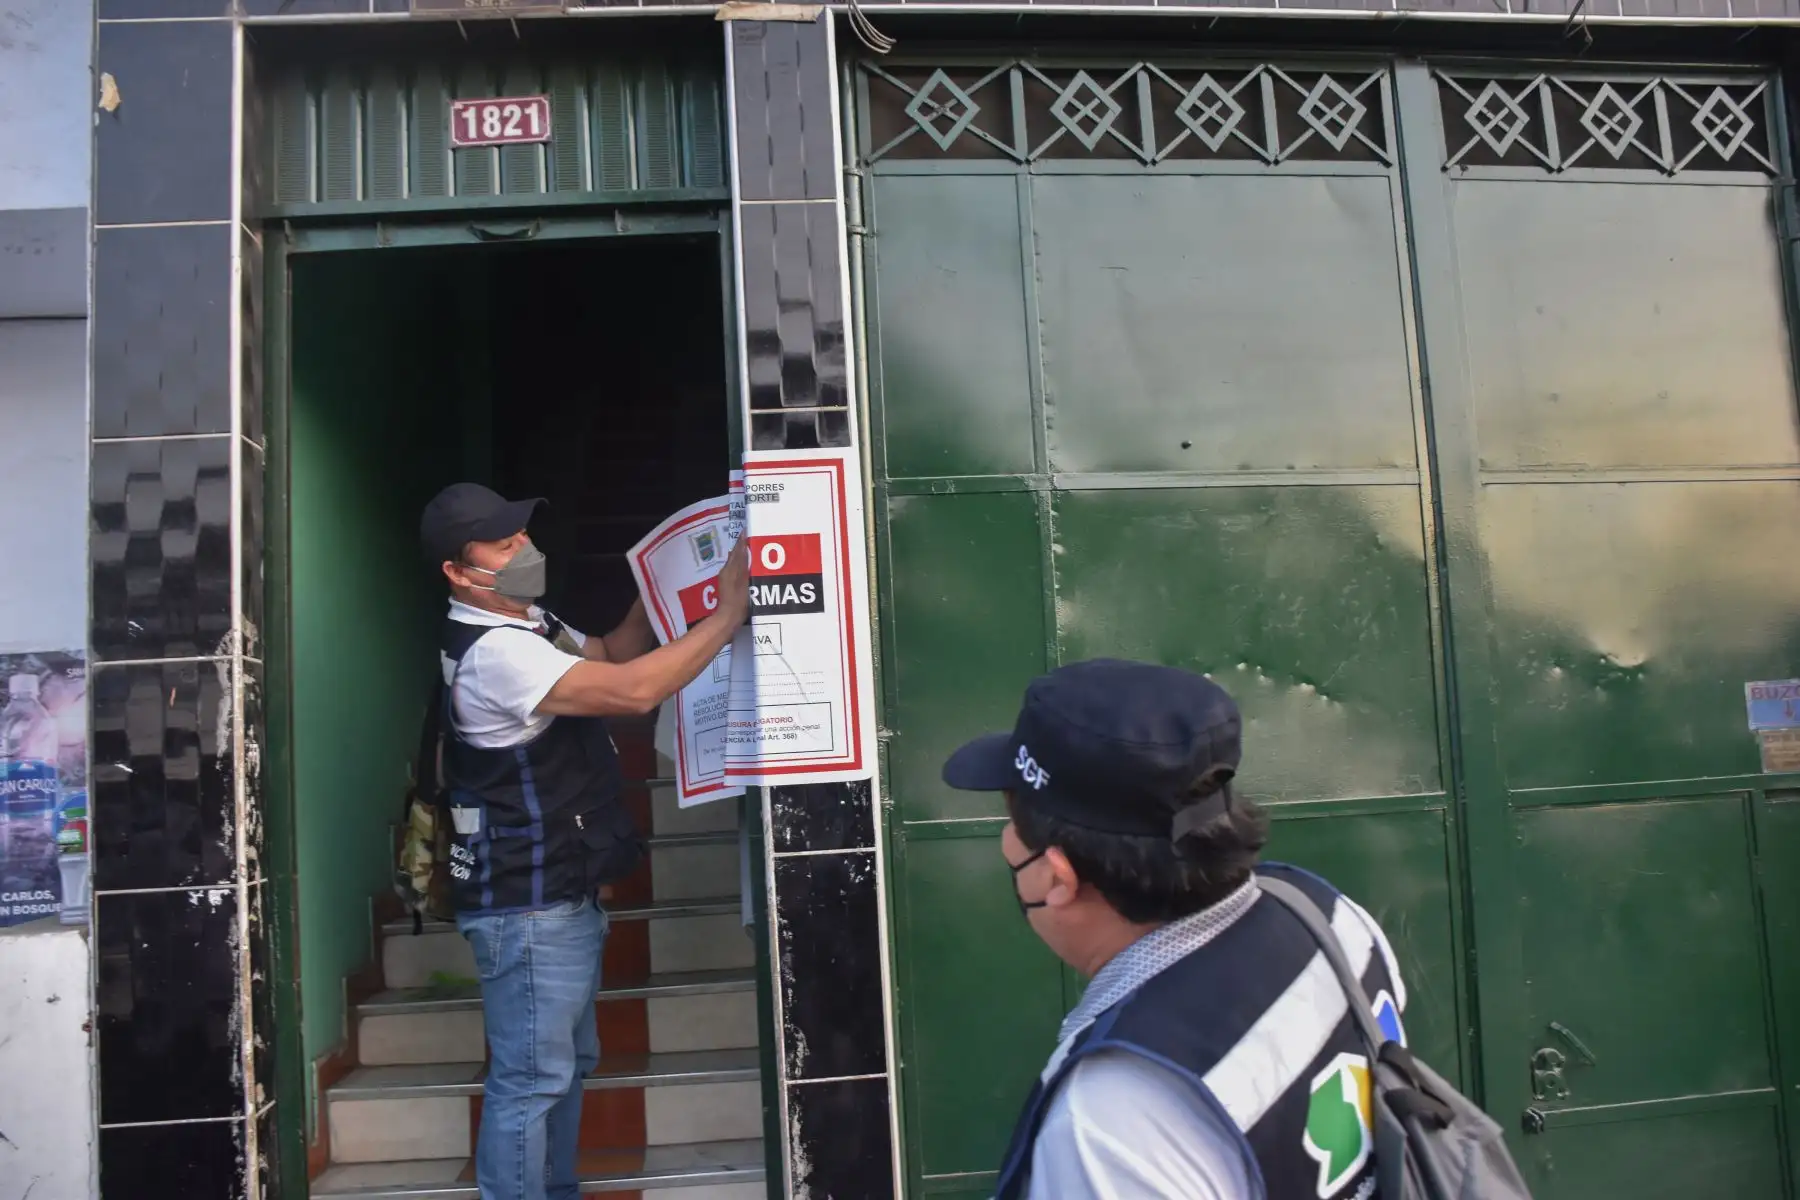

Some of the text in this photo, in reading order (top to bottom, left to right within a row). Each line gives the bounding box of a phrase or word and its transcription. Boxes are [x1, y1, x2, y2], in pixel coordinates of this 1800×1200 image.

[460, 102, 540, 139] 1821
[745, 483, 785, 493] PORRES
[1014, 744, 1051, 790] SGF
[1, 889, 56, 902] CARLOS,
[12, 902, 62, 915] BOSQUE
